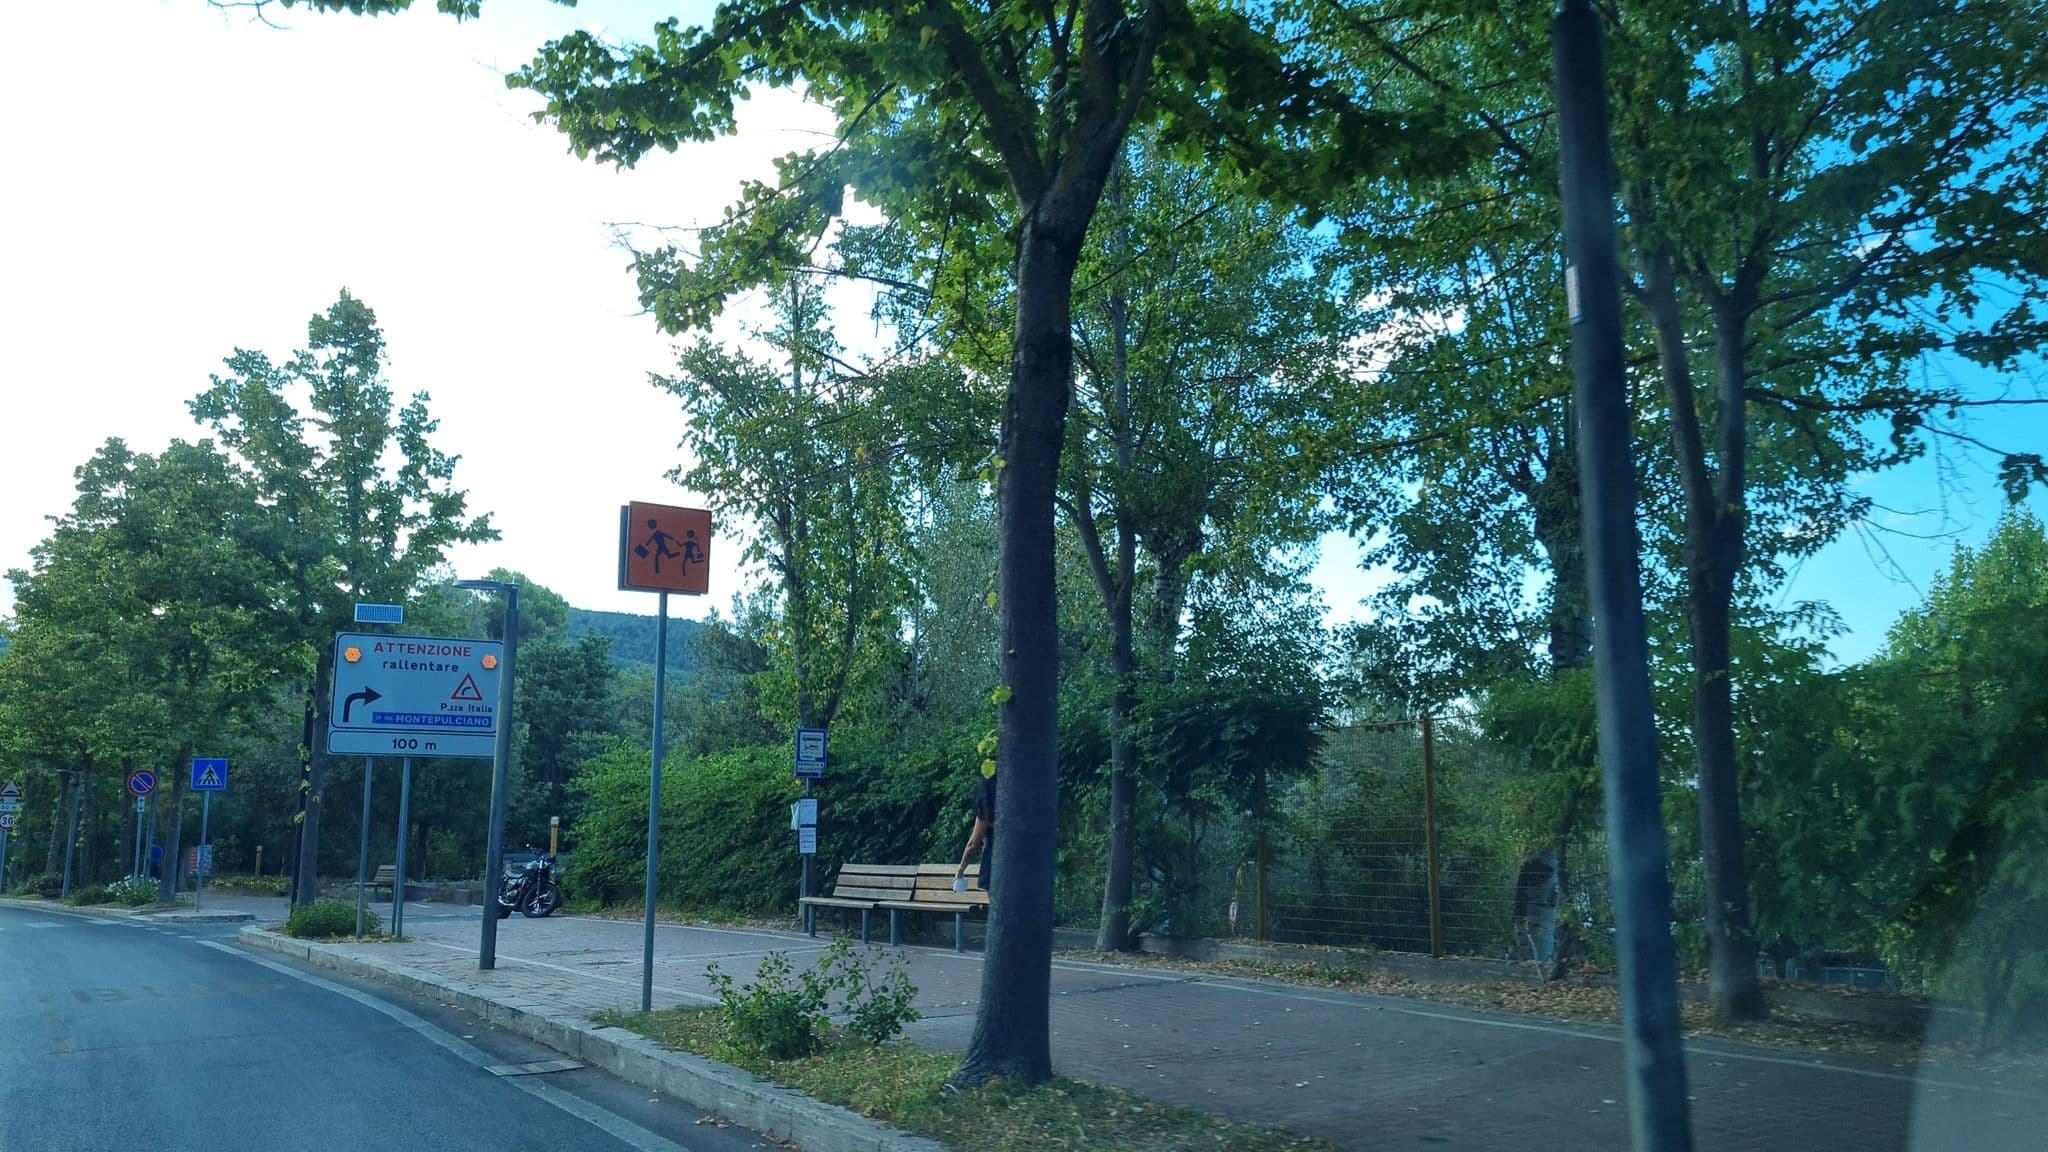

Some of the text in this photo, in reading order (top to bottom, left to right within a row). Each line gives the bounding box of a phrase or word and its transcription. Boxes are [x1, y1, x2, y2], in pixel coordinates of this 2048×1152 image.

[374, 642, 472, 657] ATTENZIONE
[383, 660, 460, 673] rallentare
[440, 703, 493, 713] P.zza Italia
[396, 714, 490, 726] MONTEPULCIANO
[392, 738, 437, 751] 100 m
[2, 817, 13, 825] 30
